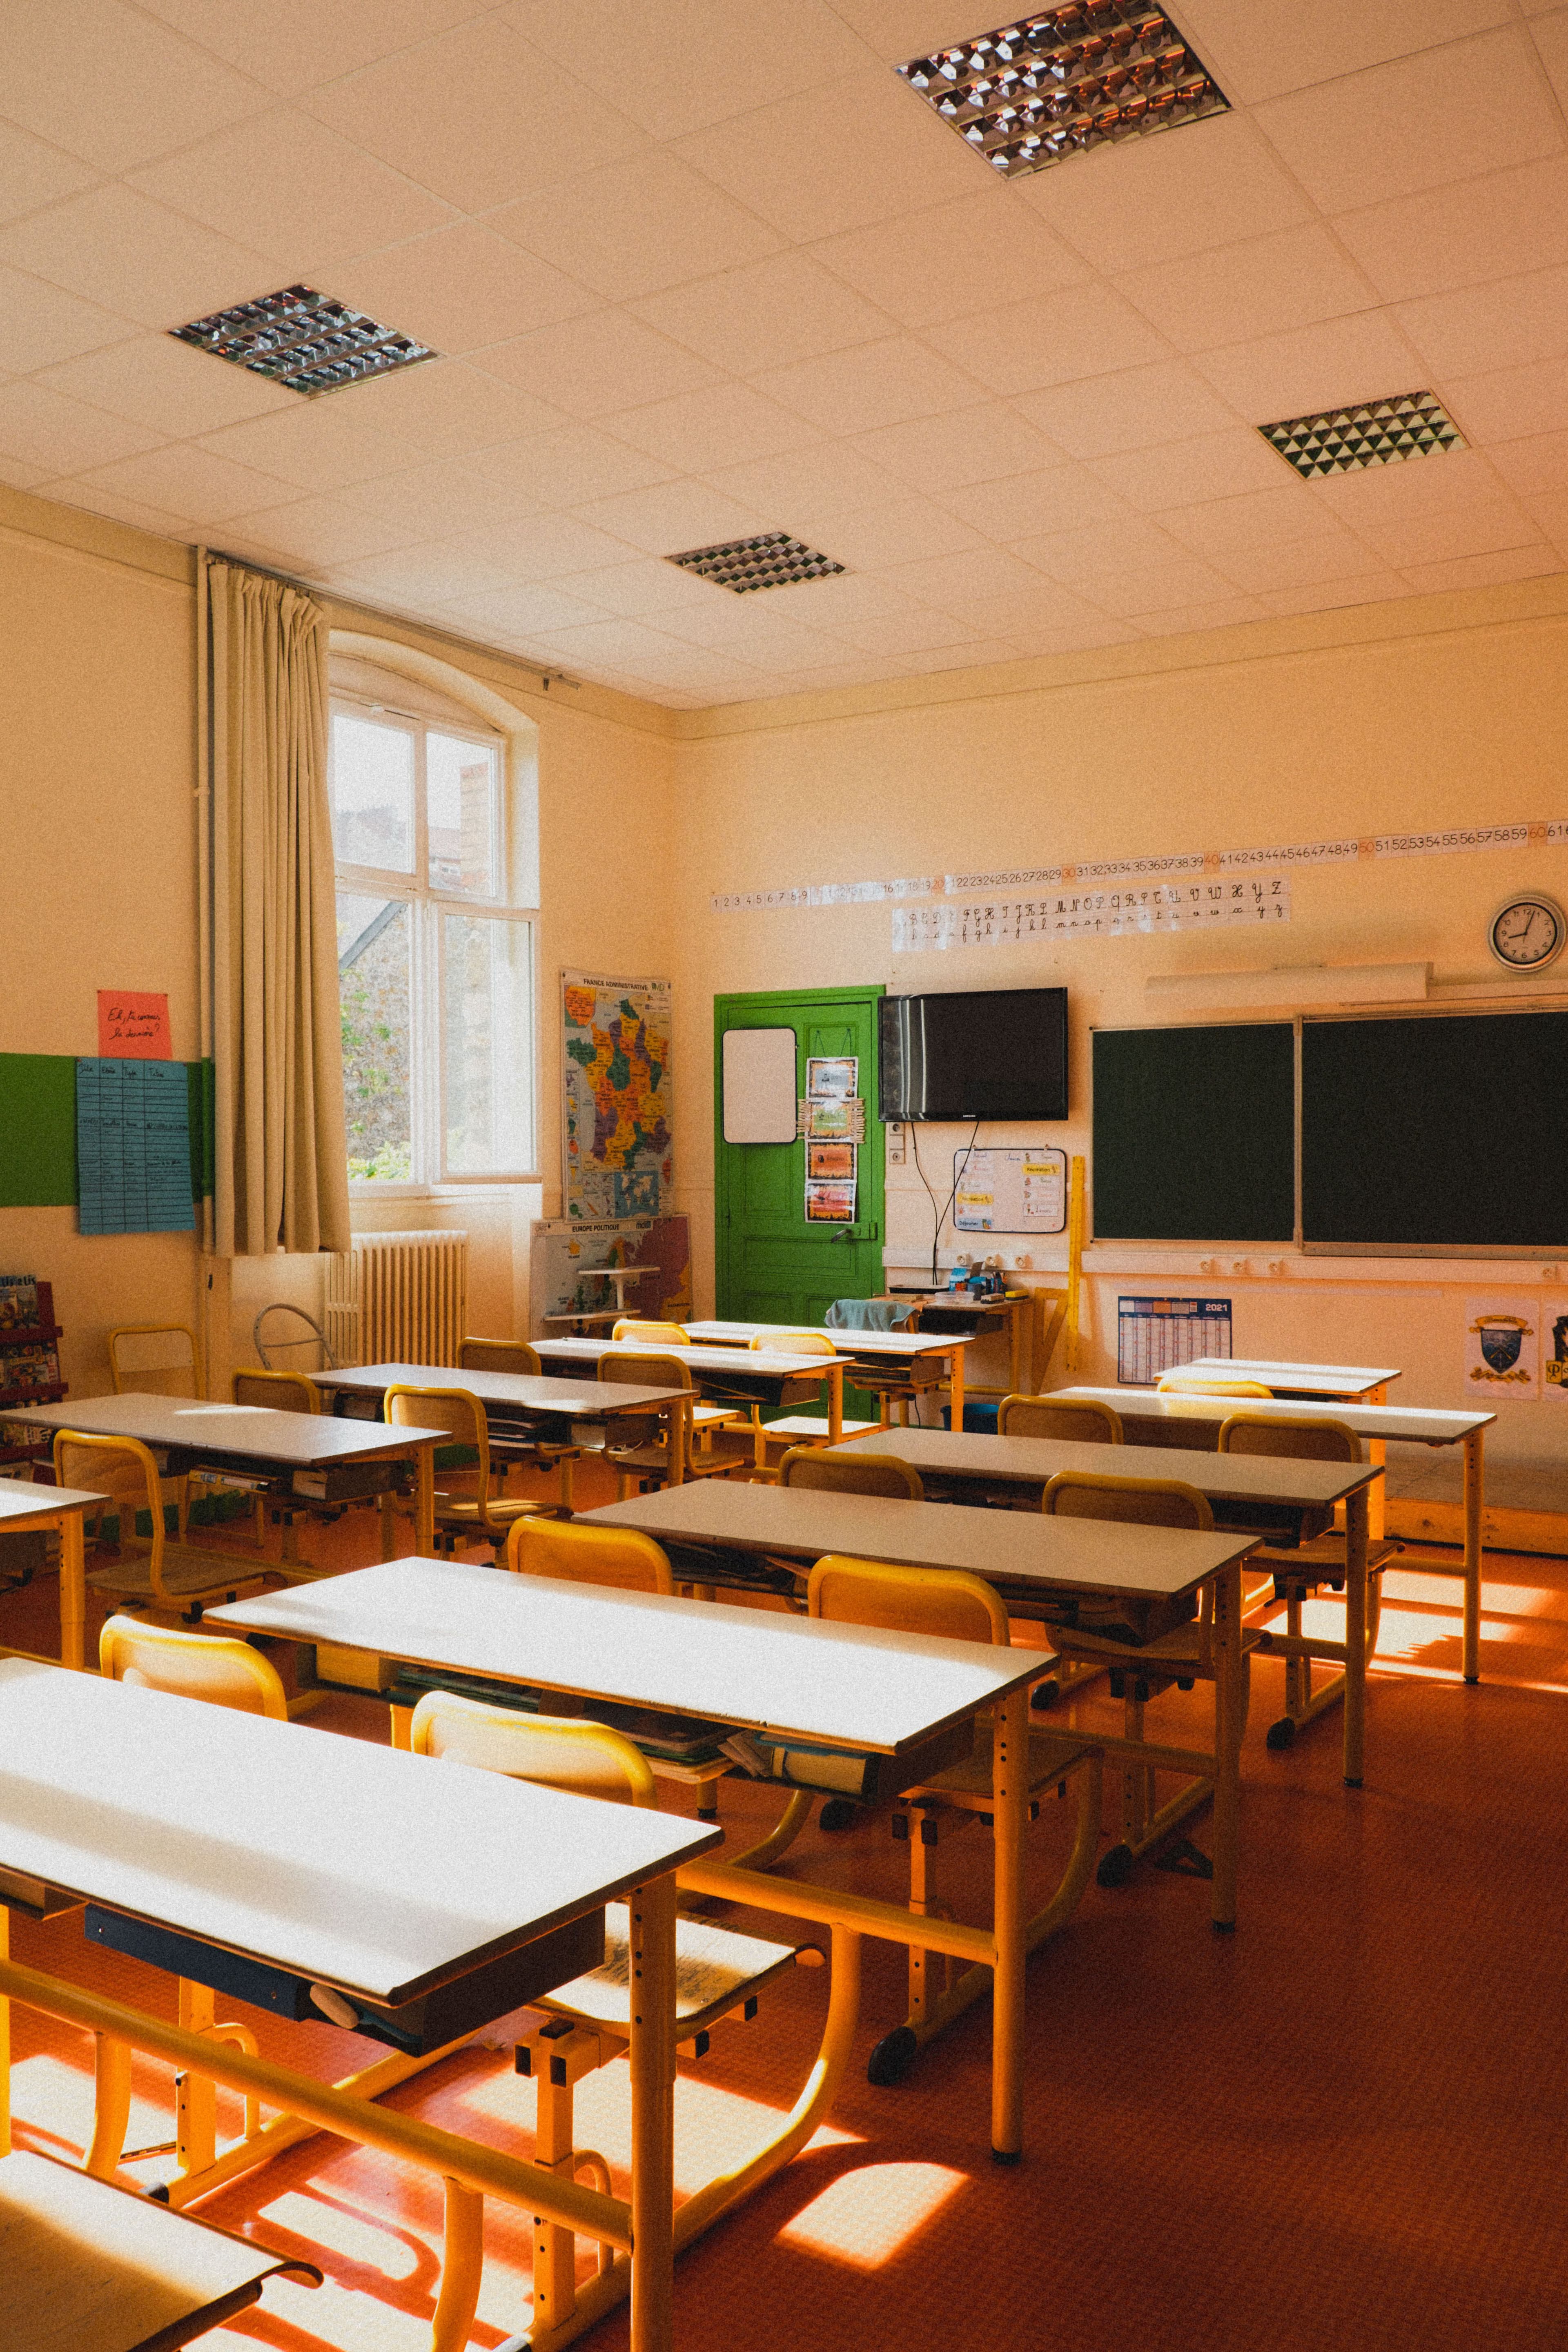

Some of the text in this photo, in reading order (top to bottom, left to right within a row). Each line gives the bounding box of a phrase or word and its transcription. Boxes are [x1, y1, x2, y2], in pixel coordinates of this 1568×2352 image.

[724, 898, 729, 906] 2
[735, 897, 739, 905] 3
[757, 895, 762, 904] 5
[768, 894, 773, 902] 6
[778, 893, 784, 902] 7
[791, 892, 797, 900] 8
[802, 891, 807, 900] 9
[884, 884, 893, 893] 16
[908, 882, 918, 891] 18
[922, 880, 931, 889] 19
[932, 880, 944, 889] 20
[957, 878, 968, 887] 22
[970, 876, 982, 886] 23
[983, 875, 994, 885] 24
[996, 874, 1008, 884] 25
[1009, 873, 1021, 883] 26
[1023, 872, 1035, 882] 27
[1036, 871, 1048, 881] 28
[1049, 869, 1061, 880] 29
[1063, 868, 1075, 878] 30
[1077, 867, 1088, 877] 31
[1090, 866, 1103, 875] 32
[1105, 864, 1117, 874] 33
[1118, 863, 1130, 873] 34
[1133, 861, 1146, 872] 35
[1147, 860, 1160, 871] 36
[1161, 859, 1173, 870] 37
[1176, 858, 1188, 868] 38
[1191, 856, 1203, 867] 39
[1205, 855, 1219, 864] 40
[1220, 854, 1232, 864] 41
[1235, 853, 1248, 863] 42
[1250, 852, 1263, 862] 43
[1266, 850, 1278, 860] 44
[1281, 849, 1294, 859] 45
[1296, 848, 1310, 858] 46
[1312, 846, 1325, 856] 47
[1328, 844, 1341, 855] 48
[1343, 843, 1358, 853] 49
[1359, 842, 1374, 853] 50
[1376, 841, 1388, 851] 51
[1392, 839, 1407, 850] 52
[1409, 837, 1424, 848] 53
[1426, 836, 1440, 847] 54
[1443, 834, 1457, 845] 55
[1460, 833, 1475, 844] 56
[1477, 831, 1492, 842] 57
[1494, 830, 1510, 841] 58
[1512, 828, 1527, 840] 59
[1530, 827, 1546, 838] 60
[1548, 825, 1562, 837] 61
[909, 914, 917, 925] B
[933, 912, 941, 924] D
[963, 909, 970, 921] F
[974, 909, 980, 927] G
[985, 908, 994, 919] H
[1016, 905, 1021, 924] J
[1025, 904, 1035, 916] K
[1040, 903, 1047, 915] L
[1056, 901, 1066, 913] M
[1070, 899, 1080, 912] N
[1084, 898, 1092, 910] O
[1096, 897, 1104, 909] P
[1125, 894, 1136, 906] R
[1154, 891, 1161, 904] T
[1169, 890, 1180, 902] U
[1190, 889, 1199, 900] V
[1208, 886, 1221, 899] W
[1232, 884, 1243, 897] X
[1252, 883, 1262, 903] Y
[1272, 881, 1281, 894] Z
[963, 924, 967, 942] f
[976, 930, 980, 942] g
[986, 923, 991, 934] h
[1016, 927, 1020, 938] j
[1030, 919, 1035, 930] k
[1042, 918, 1046, 929] l
[1096, 919, 1102, 931] p
[1257, 906, 1265, 918] y
[1275, 904, 1282, 917] z
[606, 981, 648, 990] ADMINISTRATIVE
[1205, 1303, 1228, 1312] 2021
